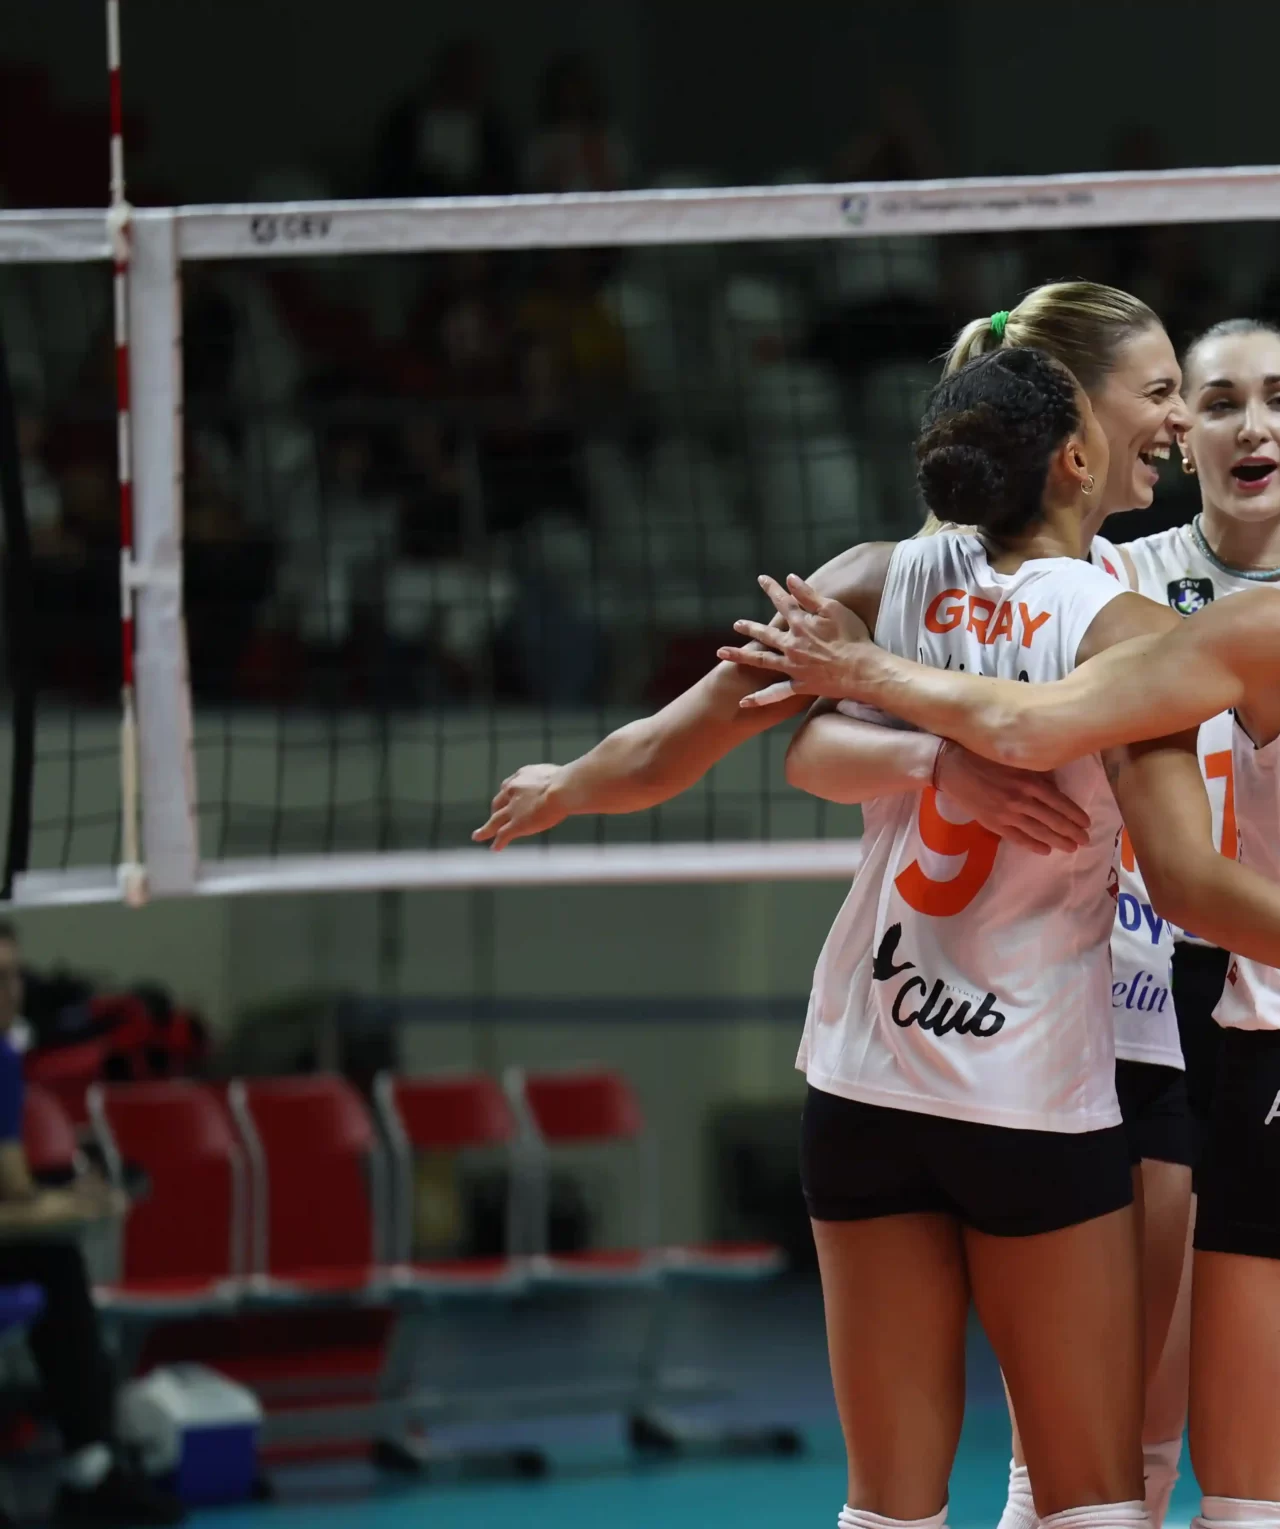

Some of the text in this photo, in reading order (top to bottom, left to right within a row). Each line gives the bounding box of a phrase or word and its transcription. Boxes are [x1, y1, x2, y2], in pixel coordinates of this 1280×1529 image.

[924, 588, 1052, 649] GRAY
[894, 786, 1002, 917] 9
[891, 974, 1006, 1037] Club
